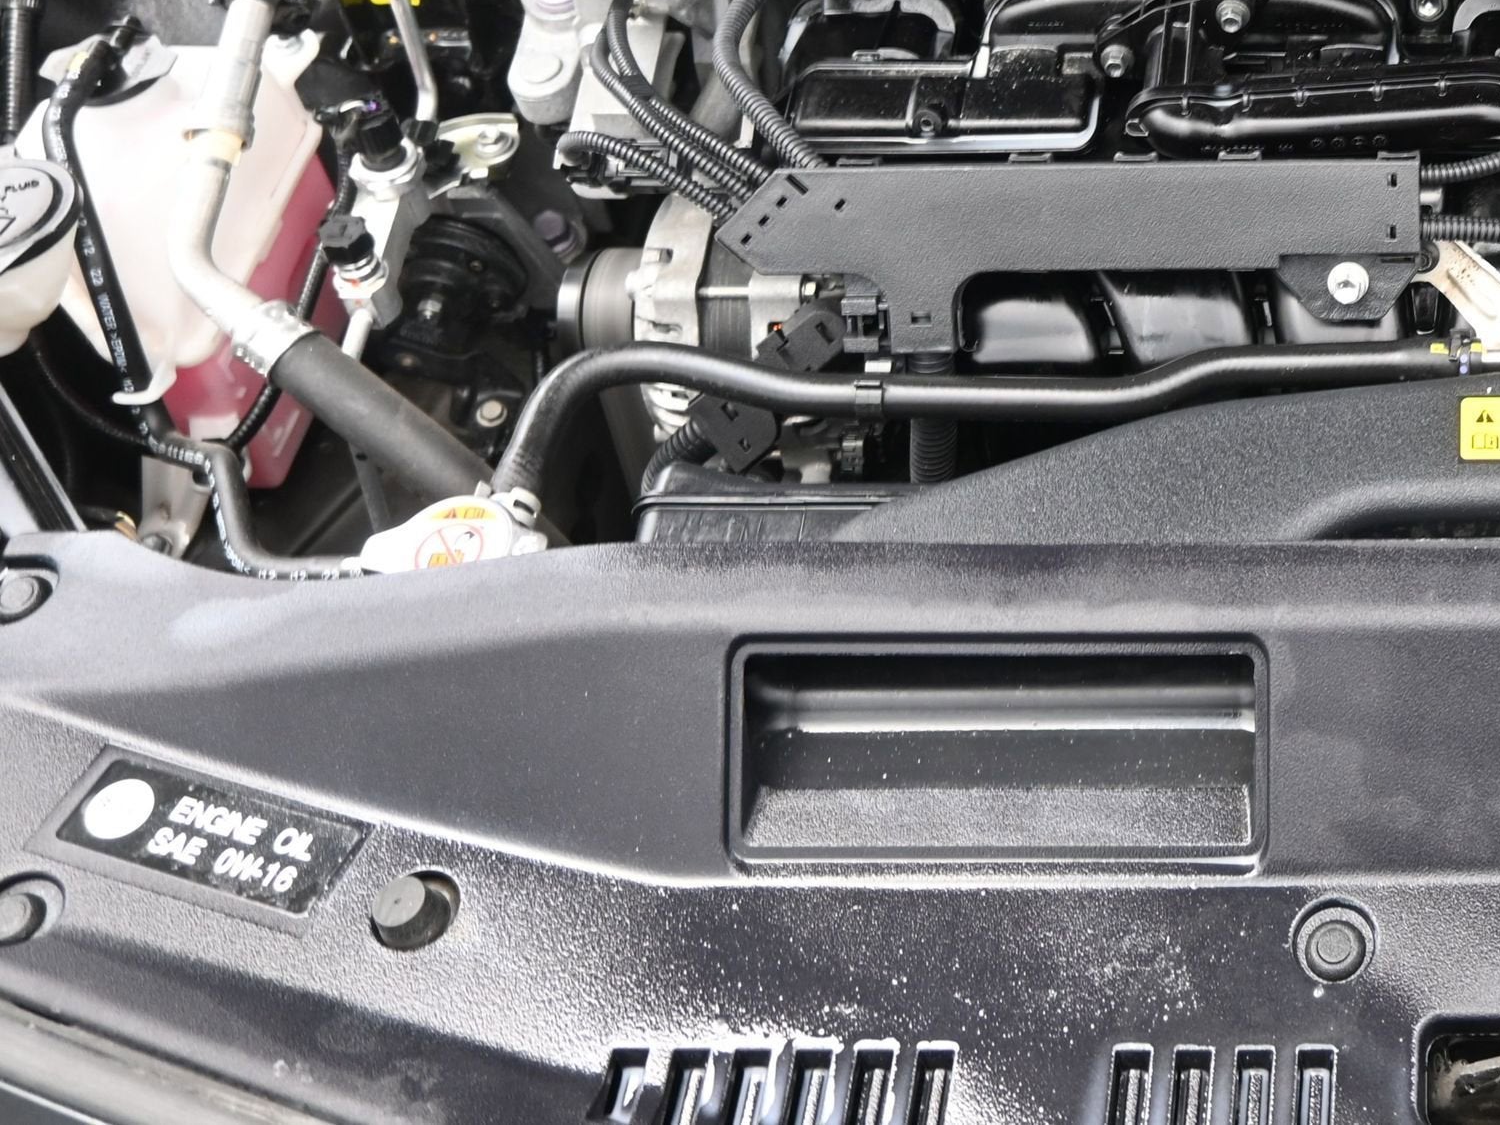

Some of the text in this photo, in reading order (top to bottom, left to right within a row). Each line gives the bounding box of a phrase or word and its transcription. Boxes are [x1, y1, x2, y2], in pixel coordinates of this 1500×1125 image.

[4, 179, 40, 193] FLUID
[97, 292, 118, 331] WATER
[168, 795, 316, 863] ENGINE OIL
[147, 826, 298, 893] SAE 0W-16
